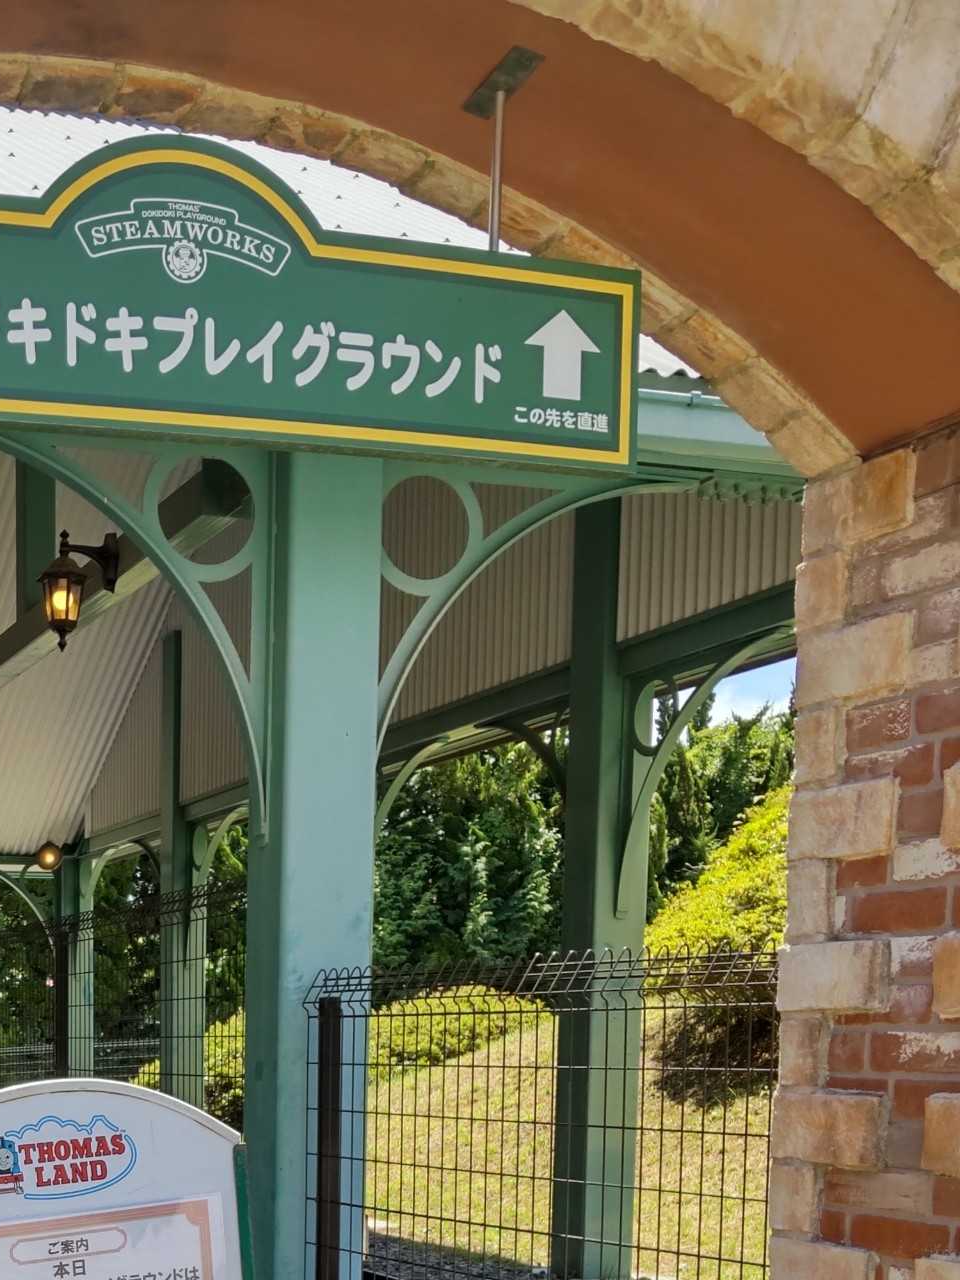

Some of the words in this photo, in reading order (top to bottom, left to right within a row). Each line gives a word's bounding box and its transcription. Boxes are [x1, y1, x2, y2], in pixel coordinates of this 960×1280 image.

[176, 211, 227, 226] PLAYGROUND
[91, 219, 276, 264] STEAMWORKS
[514, 406, 609, 433] この先を直進
[18, 1133, 126, 1165] THOMAS
[34, 1160, 108, 1188] LAND
[48, 1238, 89, 1256] ご案内
[52, 1260, 87, 1280] 本日
